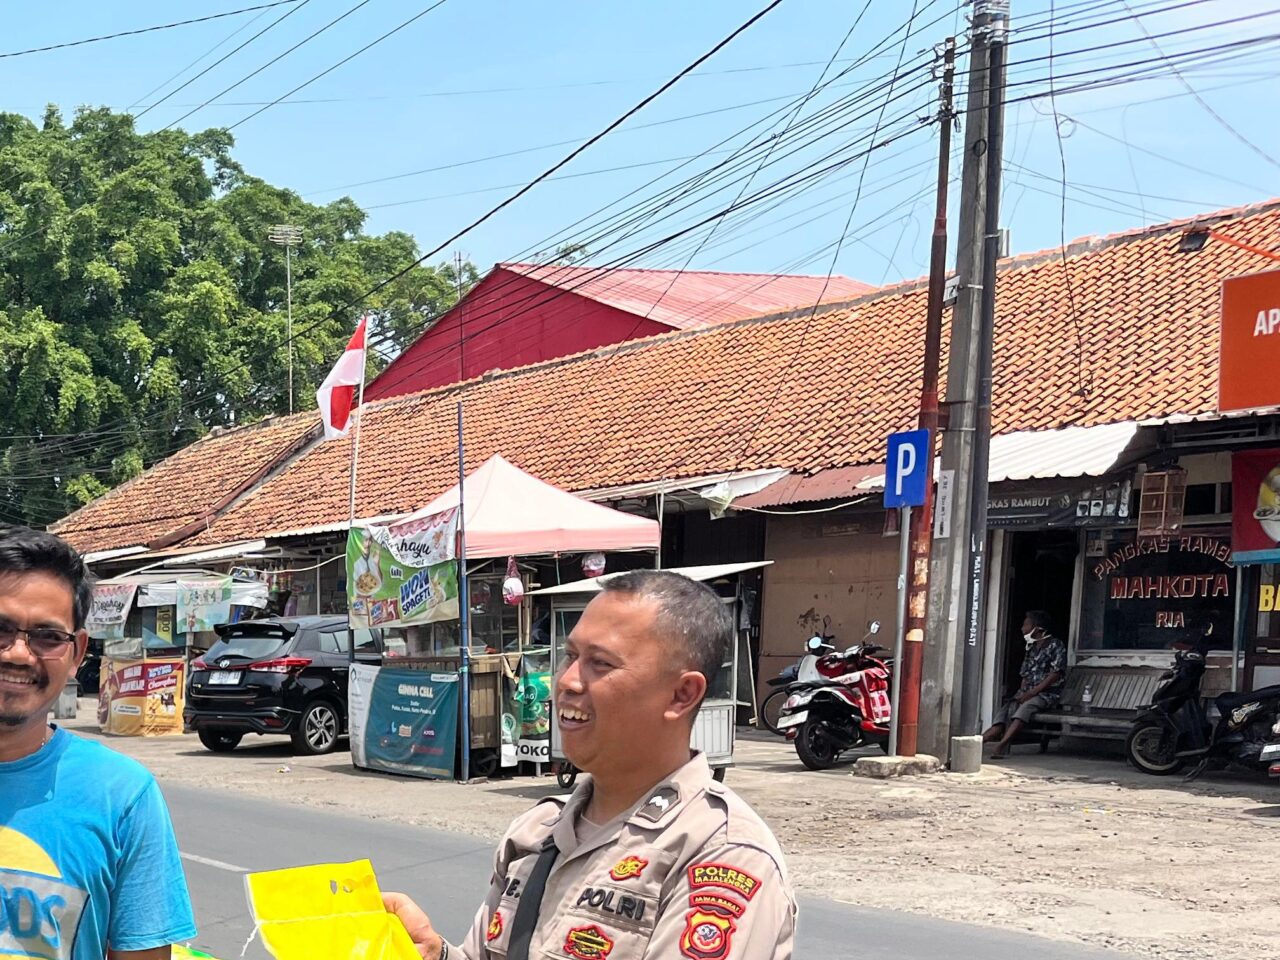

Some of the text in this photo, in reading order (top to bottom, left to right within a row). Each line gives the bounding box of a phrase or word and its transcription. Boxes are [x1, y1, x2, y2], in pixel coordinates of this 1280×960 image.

[1253, 308, 1280, 337] AP
[895, 442, 916, 496] P
[1011, 497, 1052, 508] RAMBUT
[1094, 536, 1170, 580] PANGKAS
[1111, 574, 1229, 599] MAHKOTA
[1156, 611, 1185, 628] RIA
[695, 866, 754, 888] POLRES
[695, 876, 749, 894] MAJALENGKA
[577, 887, 647, 921] POLRI
